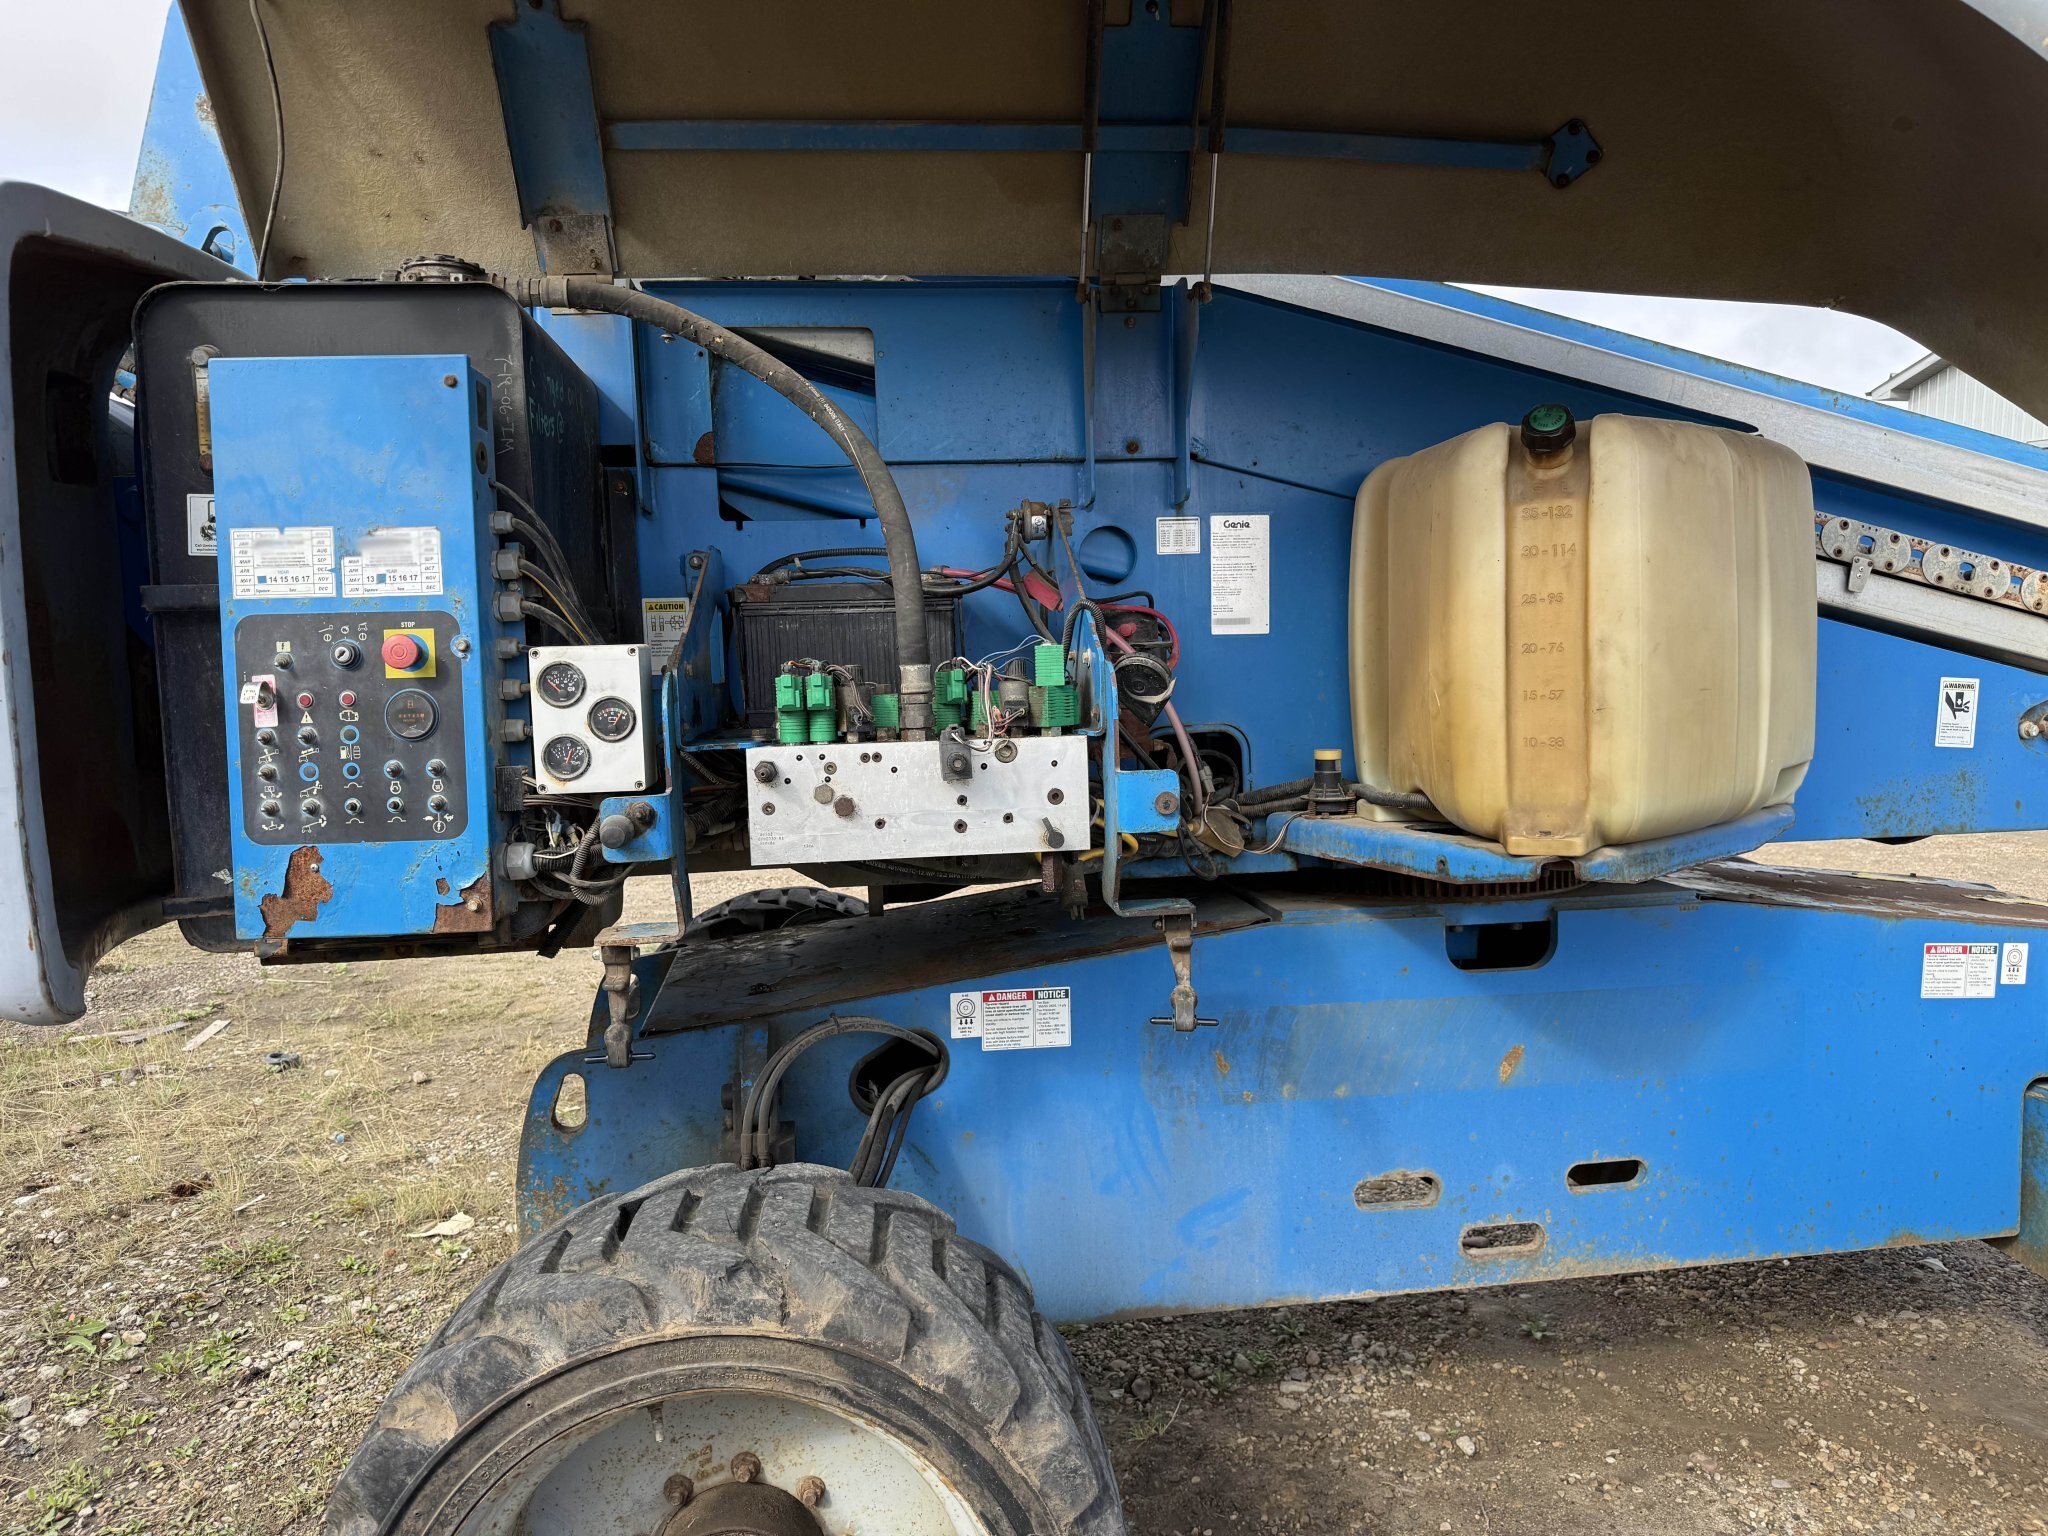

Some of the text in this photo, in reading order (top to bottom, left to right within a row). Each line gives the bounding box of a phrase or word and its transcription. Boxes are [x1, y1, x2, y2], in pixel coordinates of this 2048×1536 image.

[1223, 520, 1251, 529] Genie
[1948, 682, 1975, 690] WARNING
[1937, 946, 1963, 954] DANGER
[1971, 945, 1996, 954] NOTICE
[996, 991, 1027, 1001] DANGER
[1037, 990, 1066, 999] NOTICE
